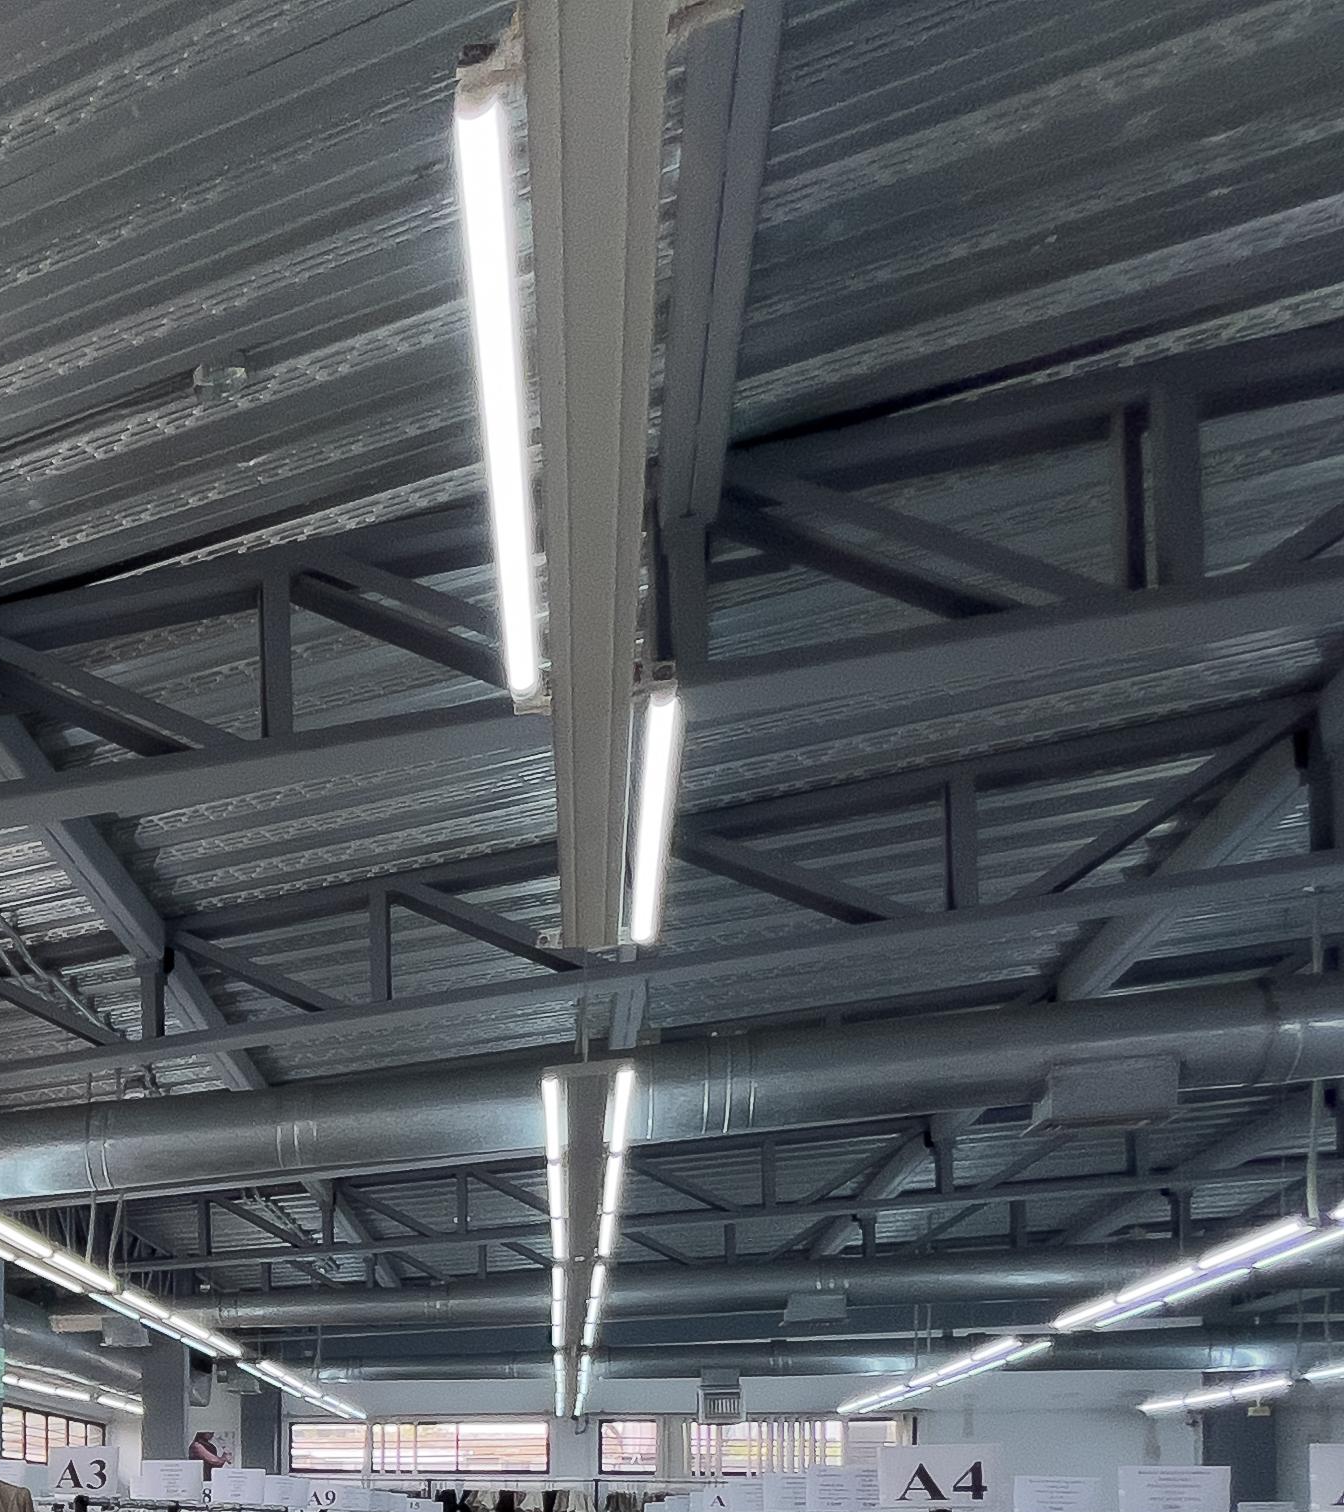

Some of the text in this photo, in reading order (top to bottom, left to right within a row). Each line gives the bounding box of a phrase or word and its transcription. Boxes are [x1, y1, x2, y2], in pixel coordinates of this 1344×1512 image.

[56, 1459, 107, 1490] A3
[894, 1461, 988, 1501] A4
[309, 1489, 337, 1506] A9
